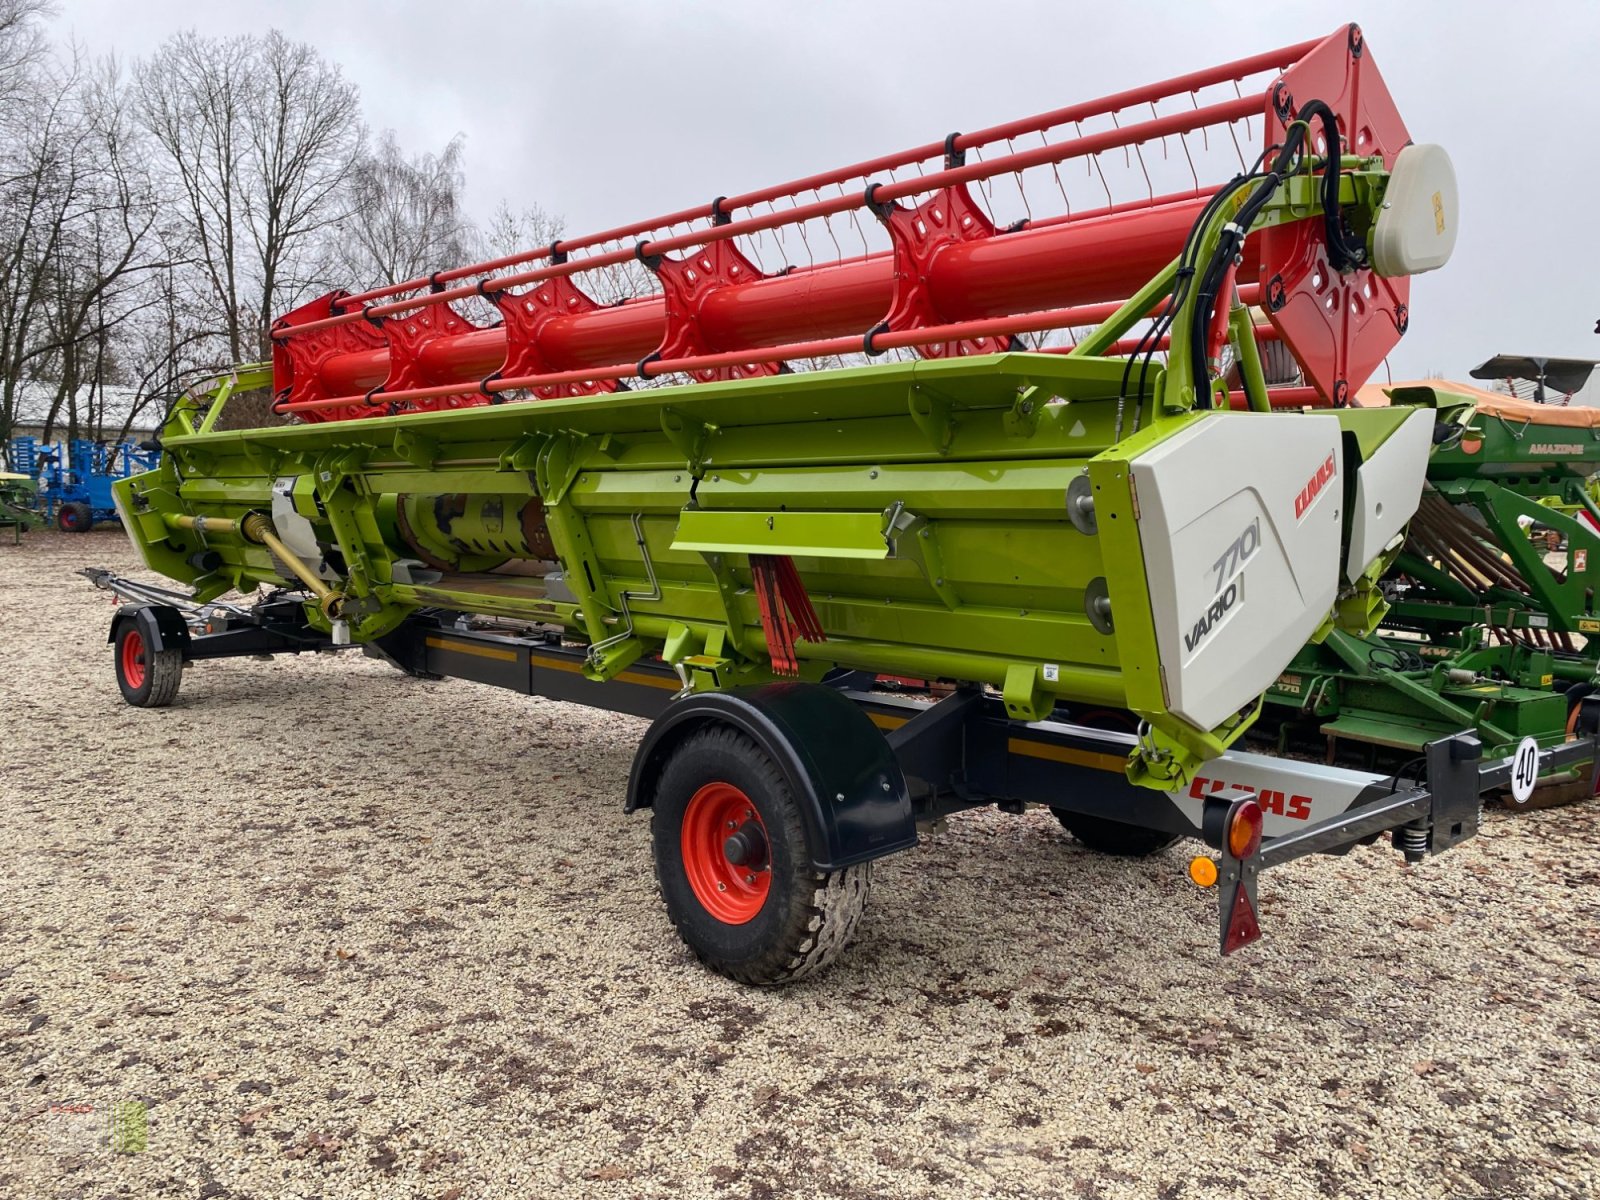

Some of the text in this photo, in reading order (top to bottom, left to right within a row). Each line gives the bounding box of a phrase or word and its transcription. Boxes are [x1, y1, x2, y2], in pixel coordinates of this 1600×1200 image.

[1528, 443, 1584, 455] AMAZONE
[1294, 454, 1334, 520] CLAAS
[1213, 524, 1257, 594] 770
[1184, 583, 1236, 653] VARIO
[1516, 746, 1535, 790] 40
